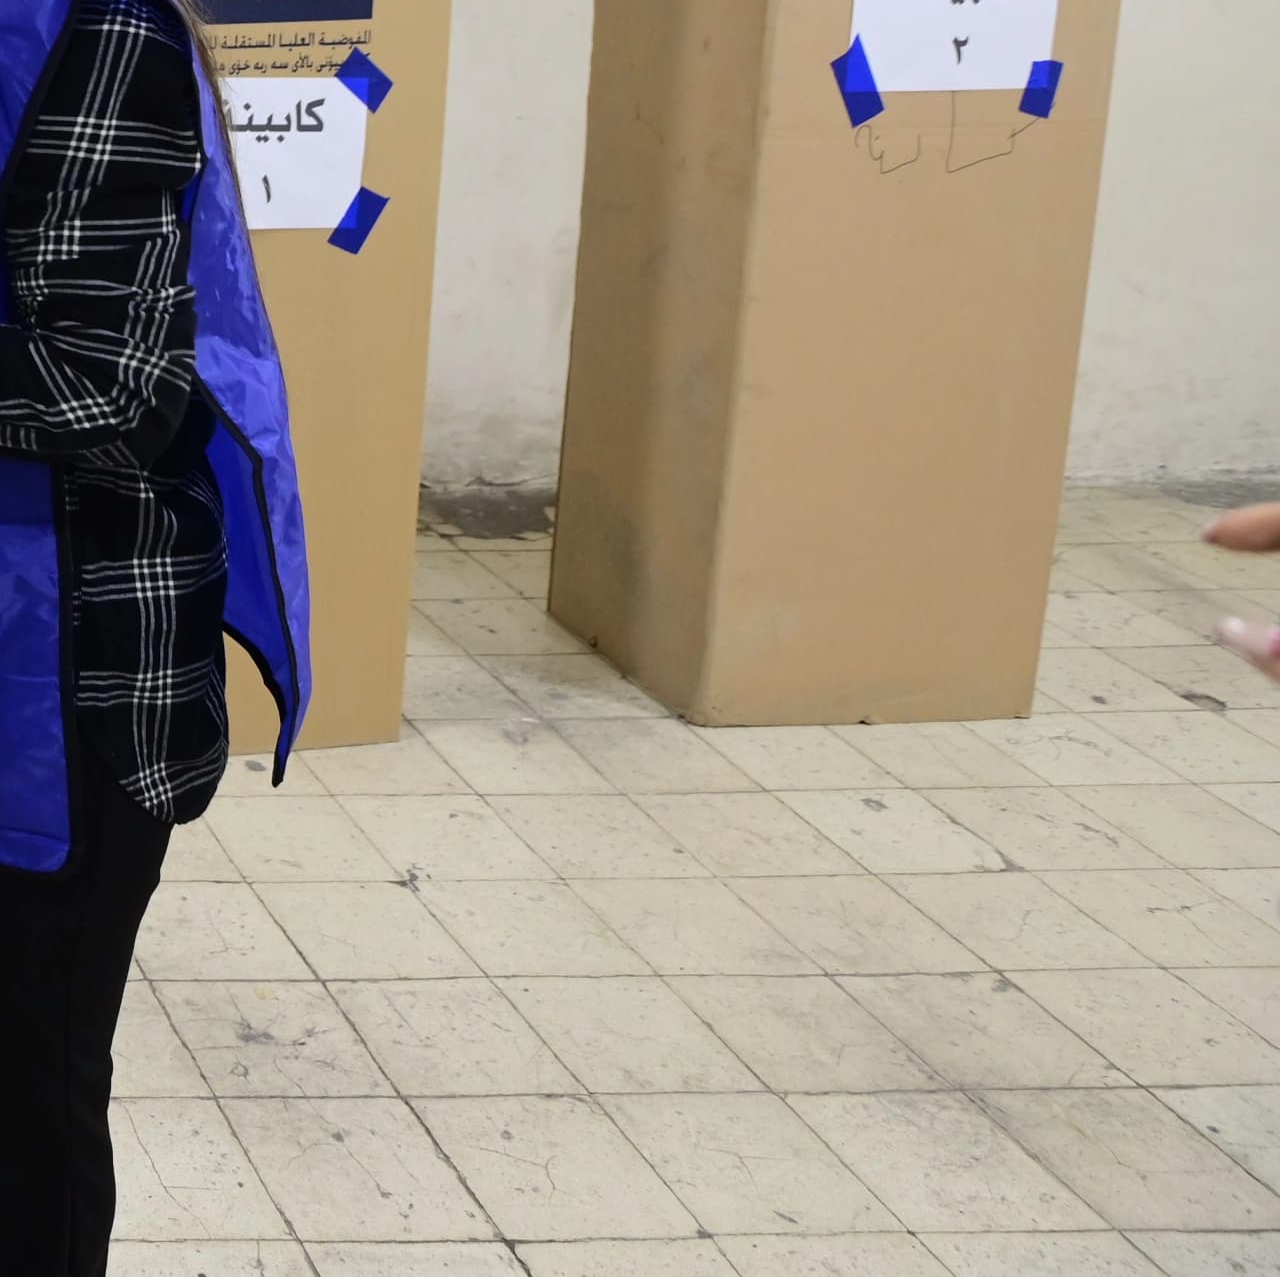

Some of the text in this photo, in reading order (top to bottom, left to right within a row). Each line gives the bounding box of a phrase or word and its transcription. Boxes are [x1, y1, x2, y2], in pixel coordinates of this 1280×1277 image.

[221, 33, 277, 49] المستقلة
[278, 31, 316, 52] العليا
[318, 29, 373, 50] المفوضية
[952, 35, 970, 66] ٢
[262, 174, 272, 204] ١
